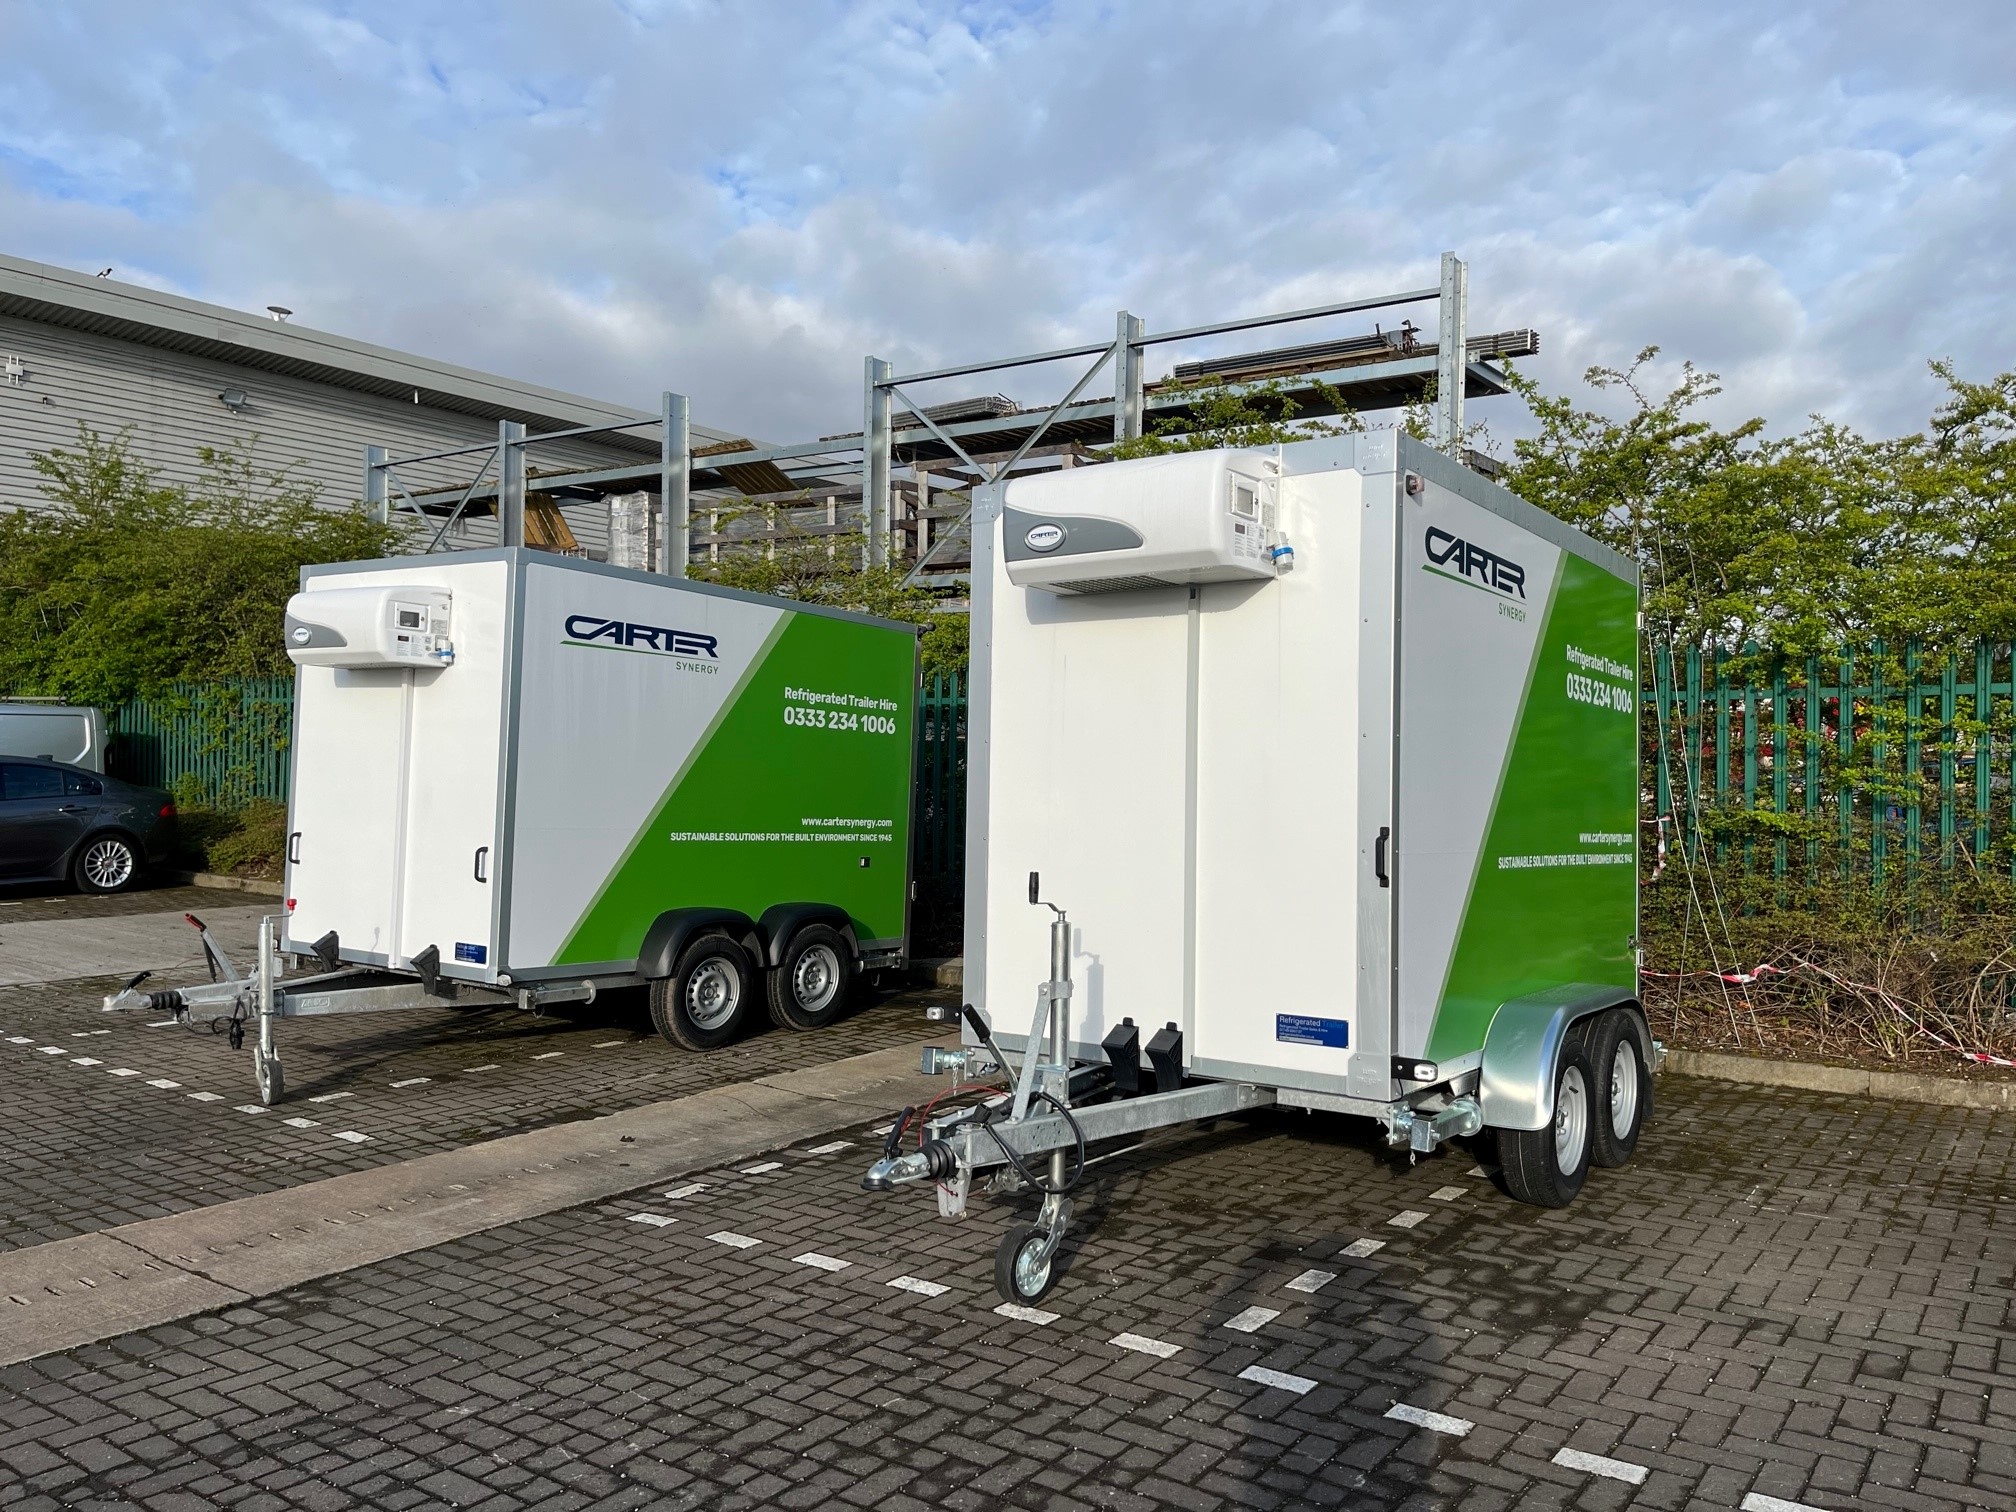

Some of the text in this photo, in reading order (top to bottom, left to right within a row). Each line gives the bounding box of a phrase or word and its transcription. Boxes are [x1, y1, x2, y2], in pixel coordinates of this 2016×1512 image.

[1030, 531, 1058, 539] CARTER
[1425, 525, 1526, 600] CARTER
[1498, 602, 1527, 623] SYNERGY
[565, 615, 719, 658] CARTER
[675, 661, 719, 675] SYNERGY
[1566, 644, 1633, 682] Refrigerated Trailer Hire
[784, 686, 898, 711] Refrigerated Trailer Hire
[1566, 672, 1633, 714] 0333 234 1006
[783, 706, 896, 734] 0333 234 1006
[801, 817, 893, 829] www.cartersynergy.com
[670, 832, 893, 842] SUSTAINABLE SOLUTIONS FOR THE BUILT ENVIRONMENT SINCE 1945
[1498, 856, 1533, 869] SUSTAINABLE
[1533, 855, 1558, 867] SOLUTIONS
[1567, 854, 1576, 866] THE
[1279, 1016, 1344, 1029] Refrigerated Trailer
